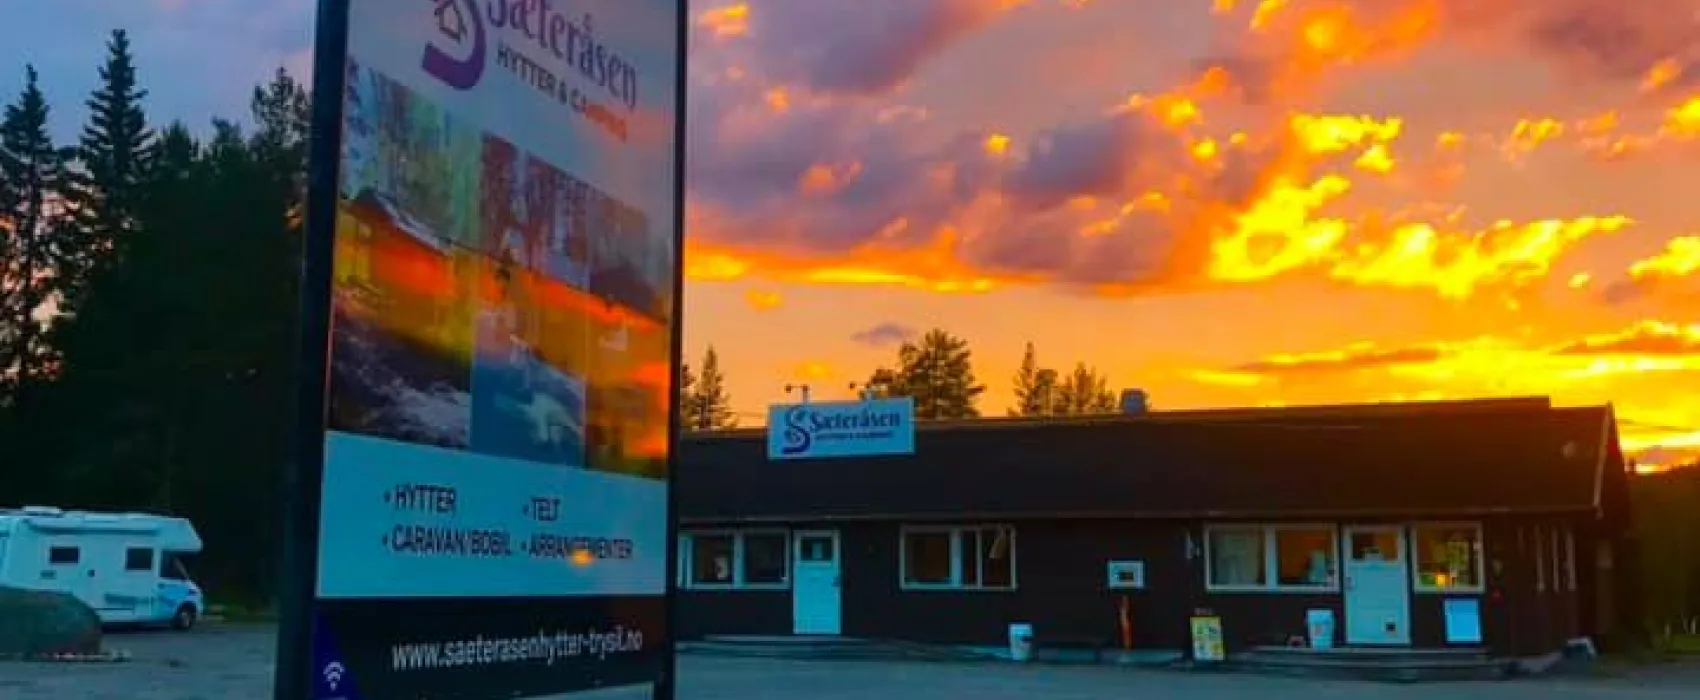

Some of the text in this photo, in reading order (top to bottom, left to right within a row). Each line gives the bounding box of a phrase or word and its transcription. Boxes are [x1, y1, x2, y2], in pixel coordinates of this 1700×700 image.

[497, 40, 557, 98] HYTTER
[396, 484, 456, 514] HYTTER
[531, 496, 561, 521] TELT
